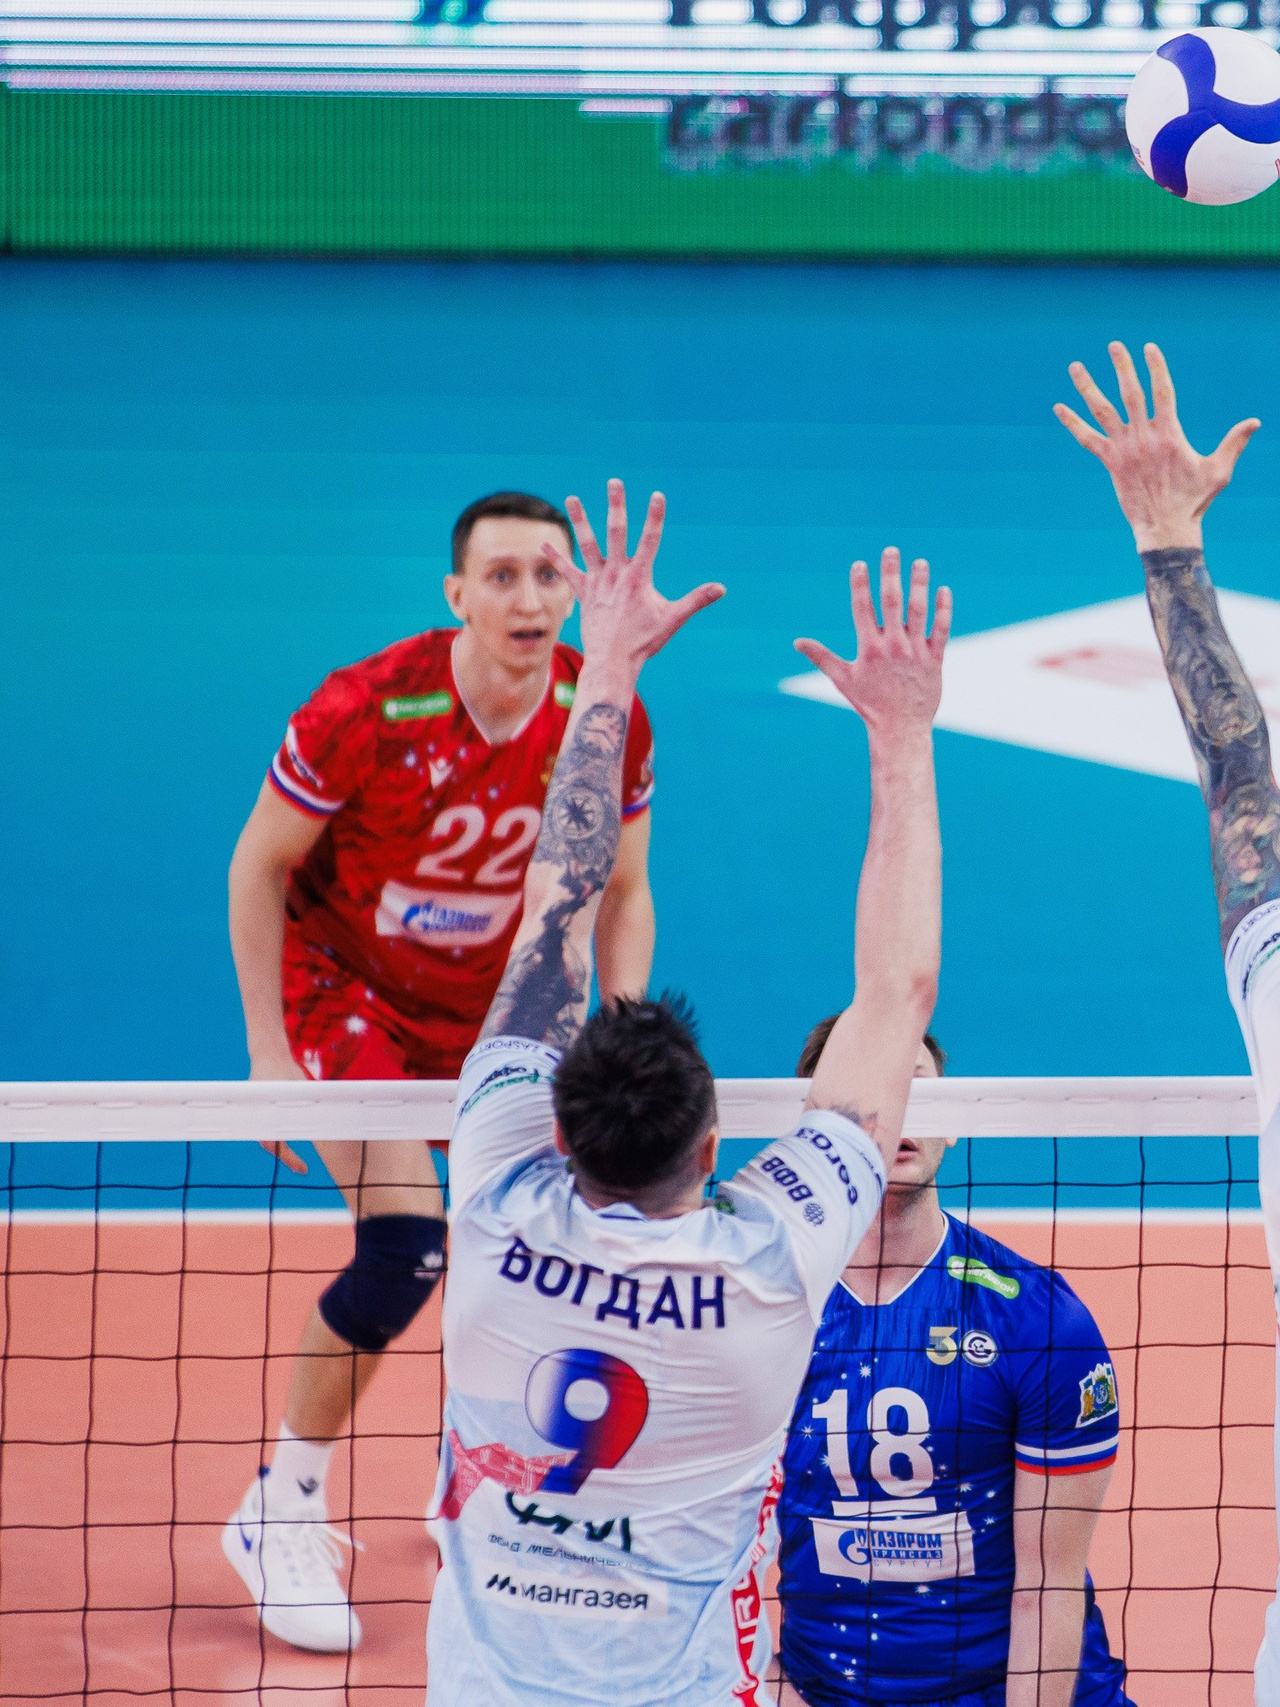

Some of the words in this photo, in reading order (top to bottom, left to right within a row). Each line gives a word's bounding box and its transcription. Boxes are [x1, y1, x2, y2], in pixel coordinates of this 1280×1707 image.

[415, 804, 541, 885] 22
[525, 1348, 649, 1495] 9
[812, 1386, 934, 1498] 18
[871, 1529, 942, 1548] ГАЗПРОМ
[873, 1549, 943, 1559] ТРАНСГАЗ
[521, 1582, 649, 1611] мангазея
